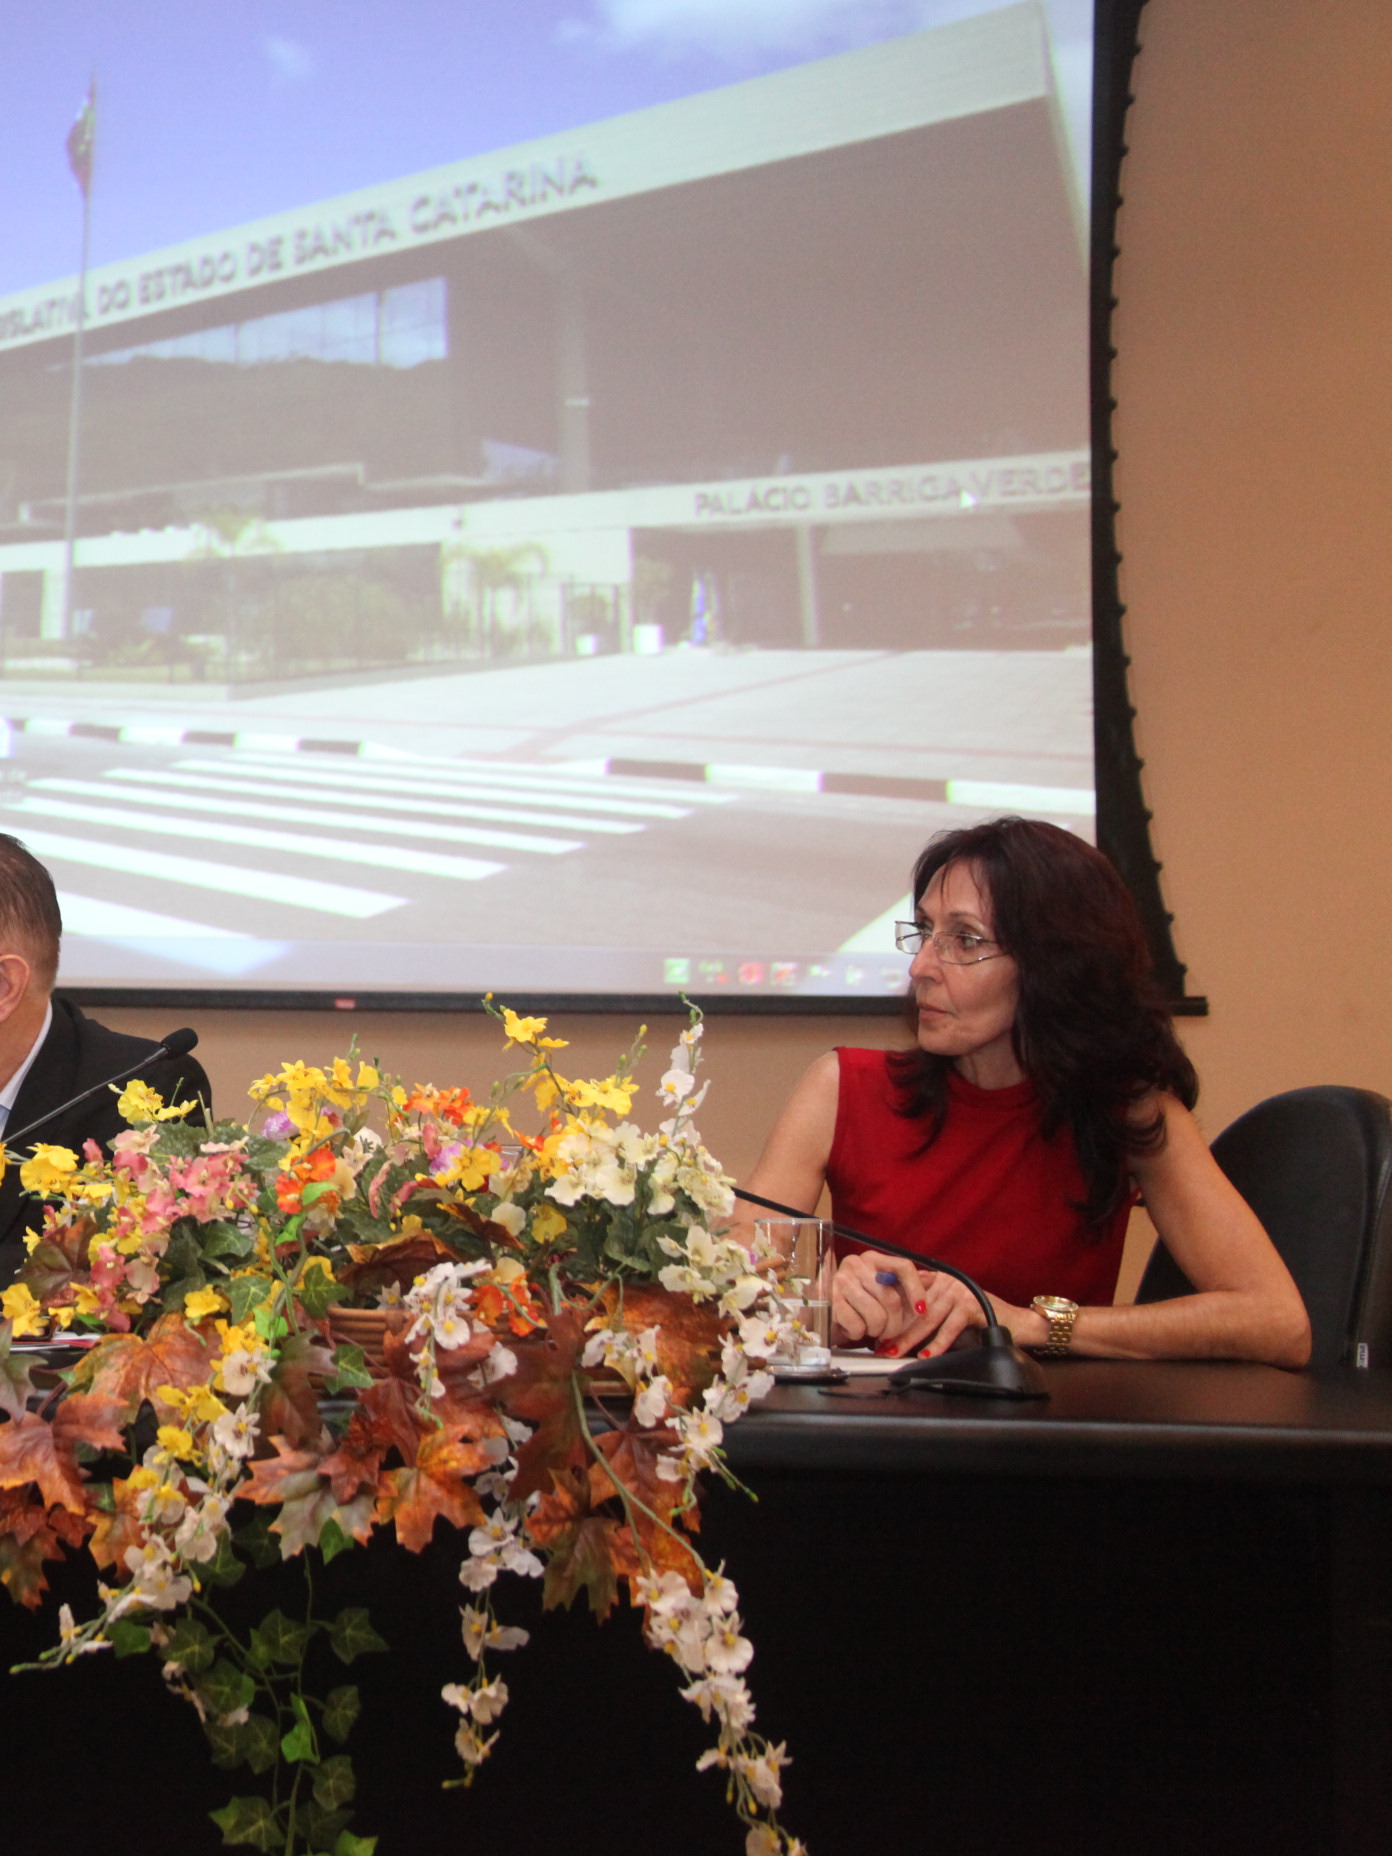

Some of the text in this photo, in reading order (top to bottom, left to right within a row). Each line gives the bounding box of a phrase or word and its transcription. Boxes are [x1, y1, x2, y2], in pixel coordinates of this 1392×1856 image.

[98, 279, 131, 315] DO
[138, 251, 238, 305] ESTADO
[247, 236, 285, 278] DE
[294, 208, 397, 266] SANTA
[409, 152, 599, 235] CATARINA
[823, 474, 962, 509] BARRIGA
[967, 460, 1092, 498] VERDE
